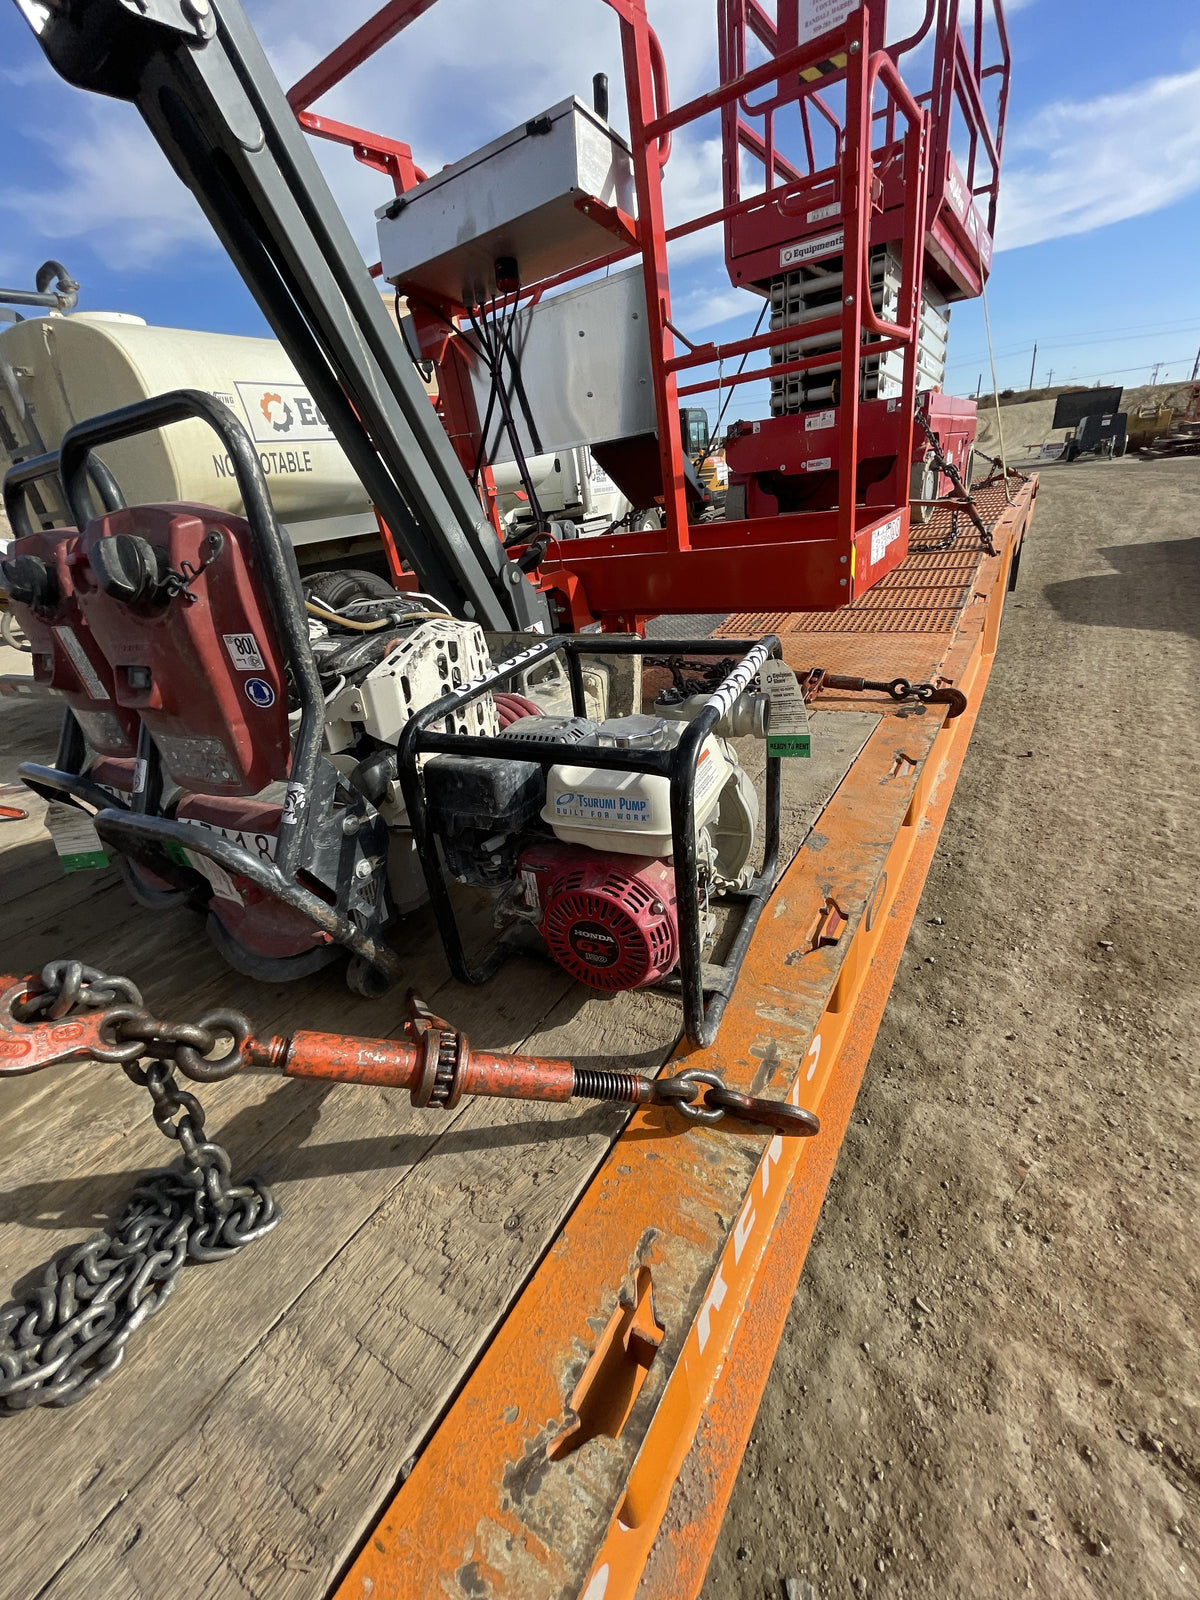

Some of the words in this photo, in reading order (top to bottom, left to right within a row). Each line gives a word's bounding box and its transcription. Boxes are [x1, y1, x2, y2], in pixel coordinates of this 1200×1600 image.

[212, 454, 236, 478] NO
[259, 450, 313, 475] OTABLE
[796, 743, 809, 751] RENT
[556, 807, 584, 817] BUILT
[590, 810, 610, 819] FOR
[574, 929, 616, 943] HONDA
[575, 940, 613, 957] GX
